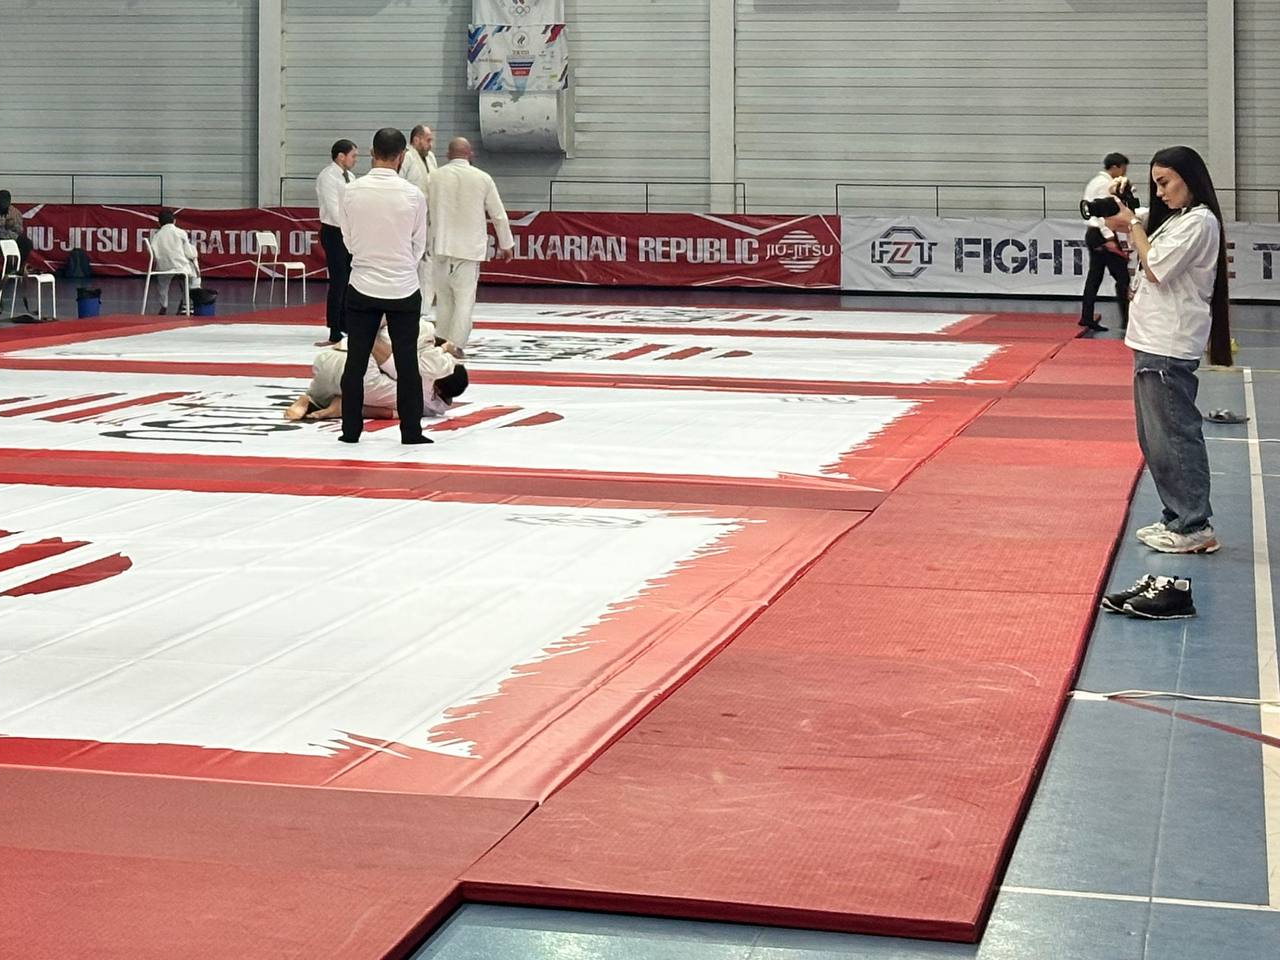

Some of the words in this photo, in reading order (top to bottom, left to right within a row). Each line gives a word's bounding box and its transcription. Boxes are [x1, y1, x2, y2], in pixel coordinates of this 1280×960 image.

[289, 230, 319, 256] OF
[638, 236, 759, 265] REPUBLIC
[765, 243, 834, 260] JIU-JITSU
[953, 236, 1088, 276] FIGHT
